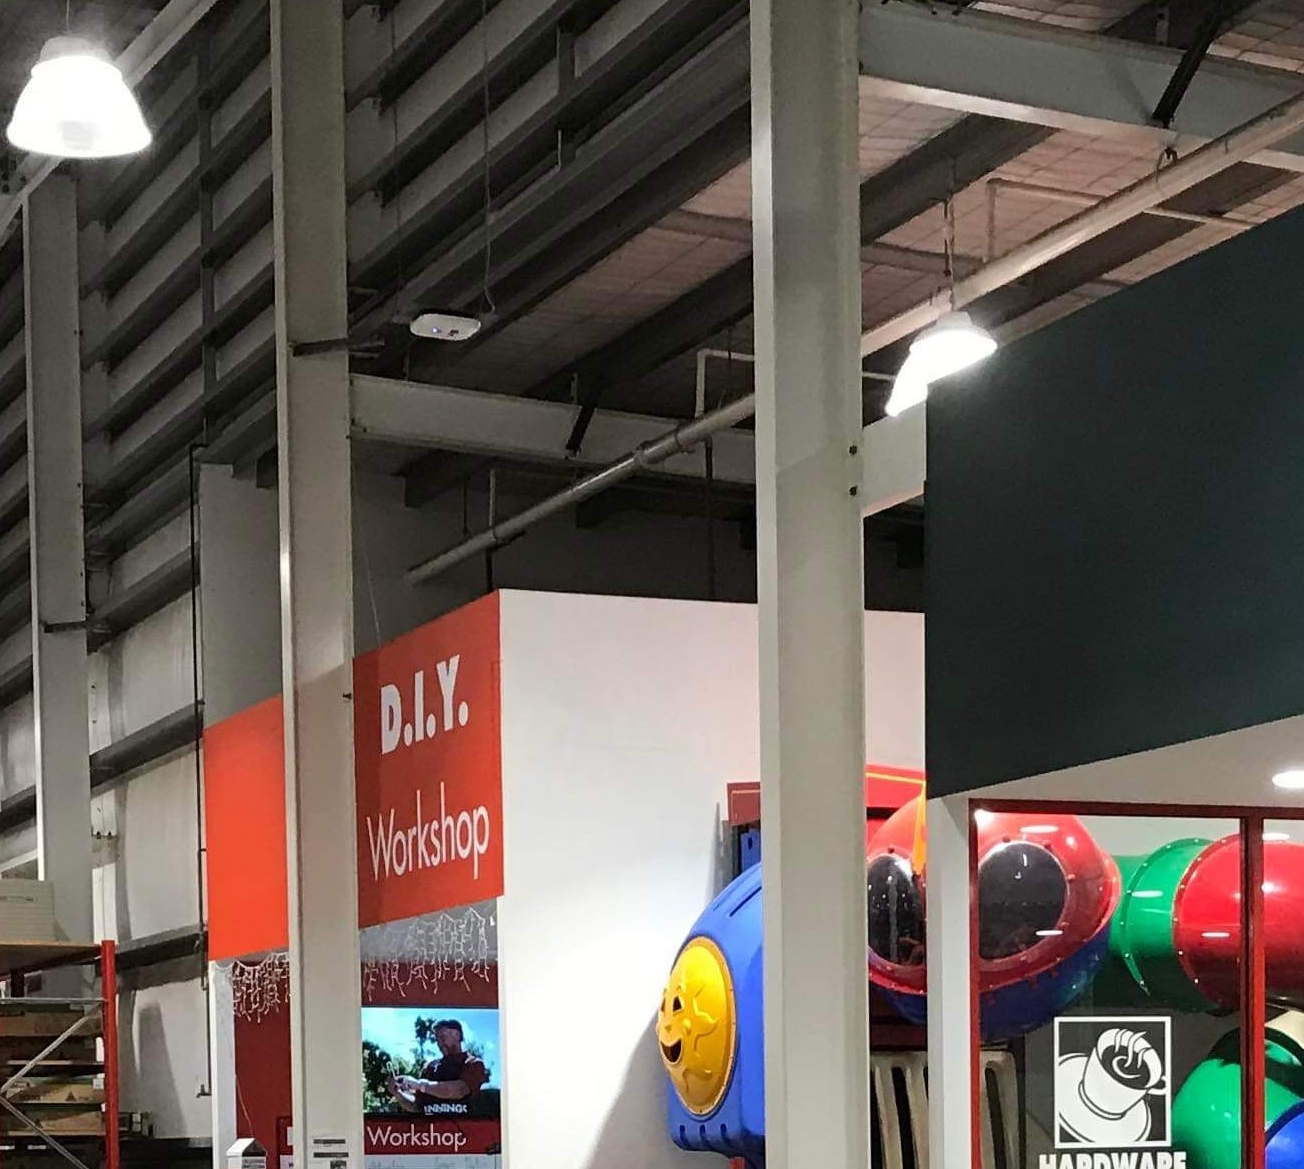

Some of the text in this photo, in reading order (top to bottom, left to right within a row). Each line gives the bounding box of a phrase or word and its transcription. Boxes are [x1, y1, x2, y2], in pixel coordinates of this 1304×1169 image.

[381, 654, 468, 754] D.I.Y.
[366, 781, 490, 881] Workshop
[366, 1122, 467, 1152] Workshop
